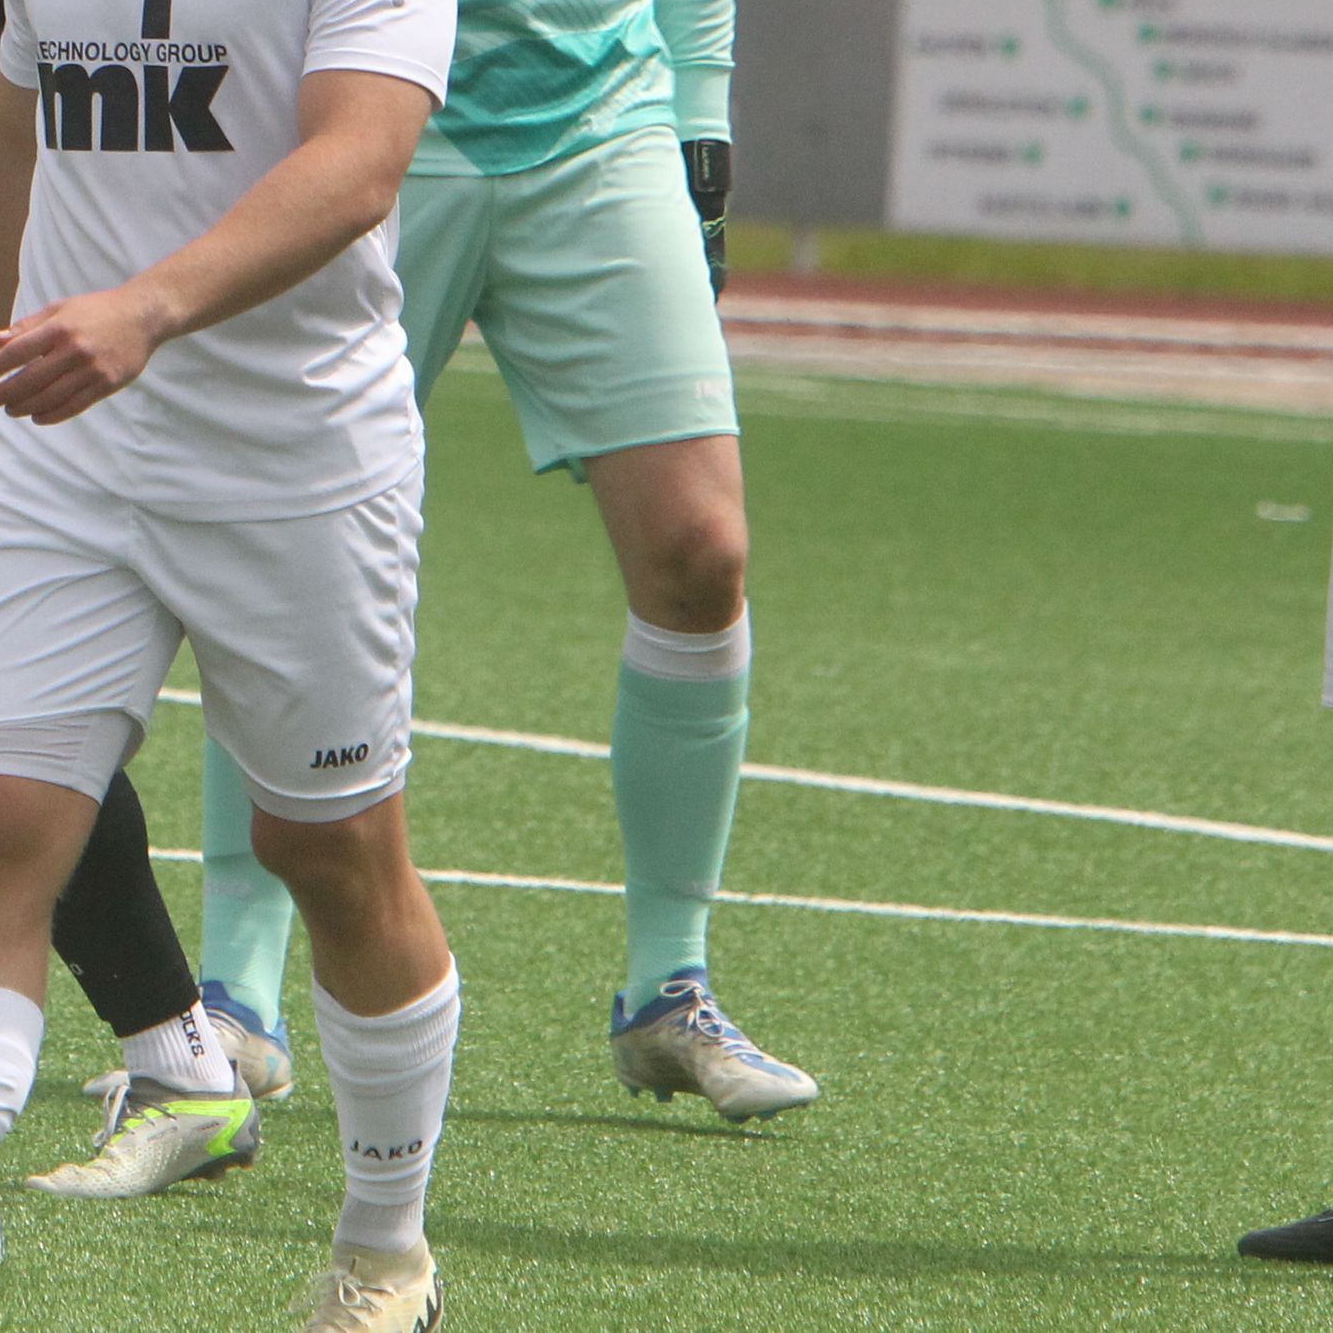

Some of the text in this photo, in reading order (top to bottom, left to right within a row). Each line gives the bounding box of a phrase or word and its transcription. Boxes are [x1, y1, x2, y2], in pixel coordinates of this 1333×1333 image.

[157, 43, 228, 64] GROUP
[309, 742, 370, 769] JAKO
[349, 1140, 424, 1161] JAKO
